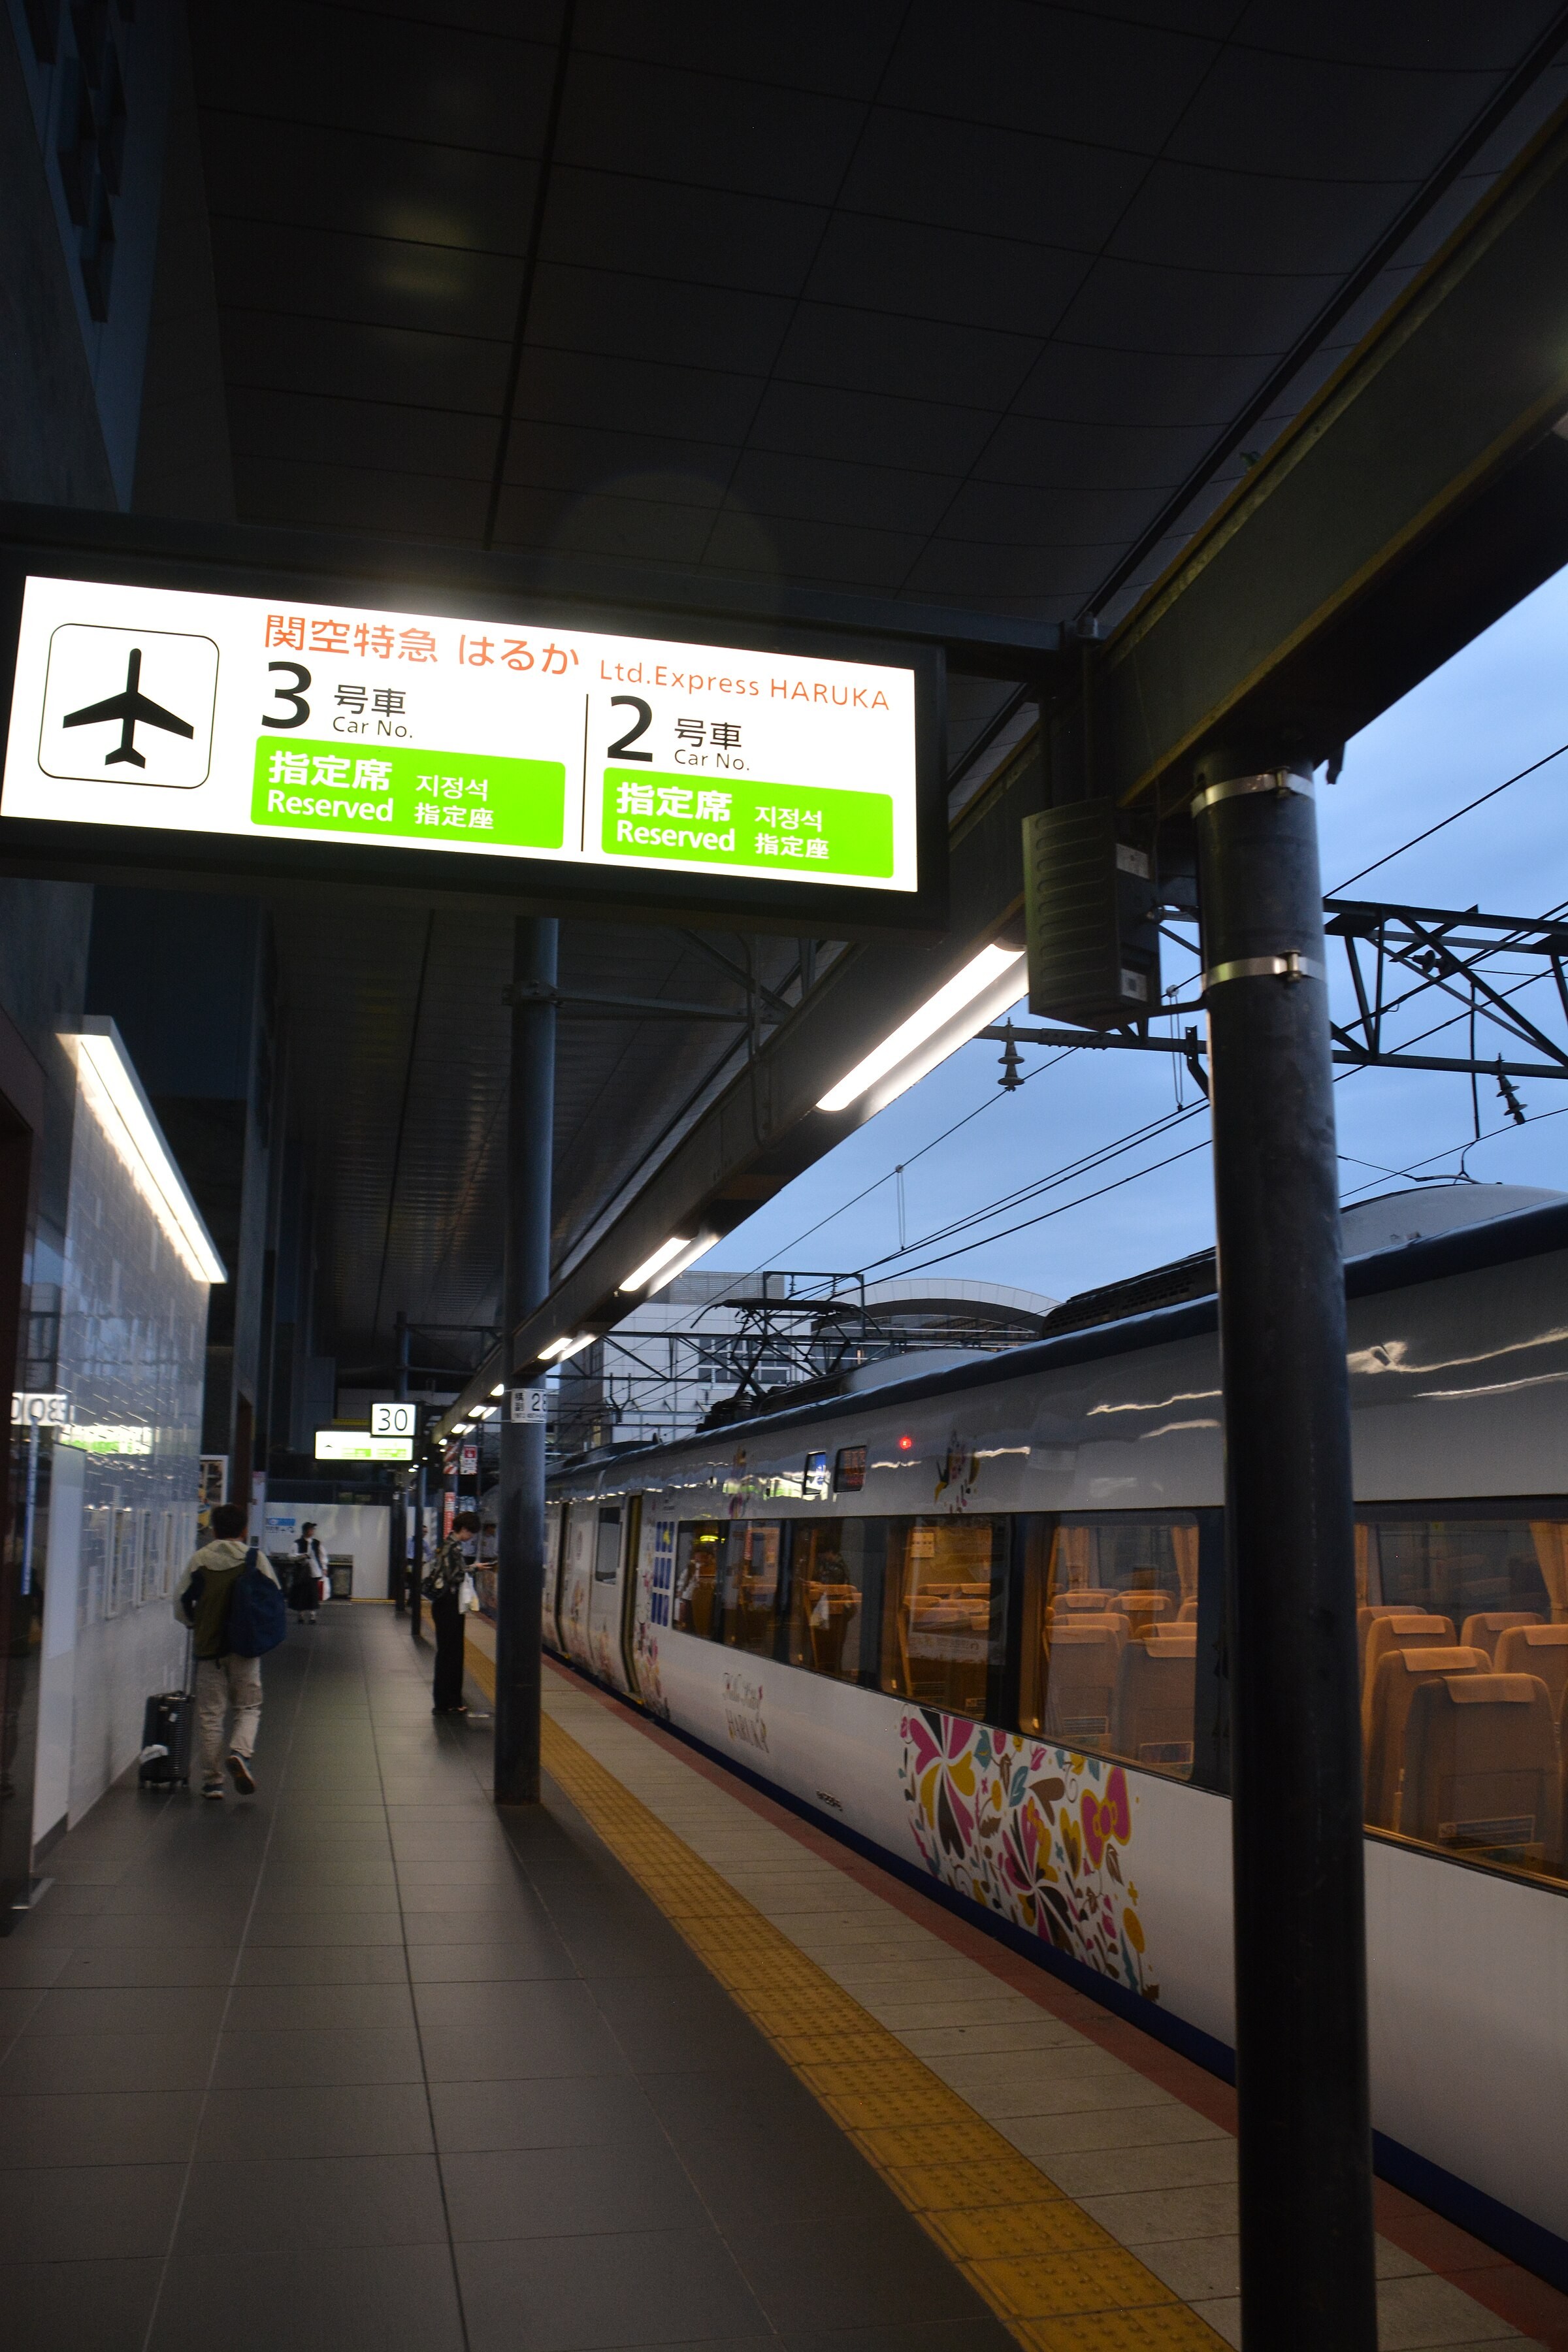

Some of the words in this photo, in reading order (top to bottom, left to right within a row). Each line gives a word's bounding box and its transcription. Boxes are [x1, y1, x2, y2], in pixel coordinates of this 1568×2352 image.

[265, 615, 437, 662] 関空特急
[459, 635, 579, 675] はるか
[601, 660, 759, 696] Ltd.Express
[772, 679, 889, 710] HARUKA
[261, 662, 312, 729] 3
[334, 685, 406, 718] 号車
[333, 716, 370, 734] Car
[378, 721, 414, 738] No.
[608, 696, 653, 762] 2
[675, 719, 742, 750] 号車
[269, 751, 393, 792] 指定席
[675, 749, 709, 766] Car
[717, 752, 749, 771] No.
[416, 775, 489, 802] 지정석
[617, 781, 733, 823] 指定席
[267, 790, 394, 823] Reserved
[415, 802, 494, 829] 指定座
[755, 806, 823, 832] 지정석
[617, 819, 736, 853] Reserved
[755, 832, 829, 859] 指定座
[378, 1409, 408, 1431] 30
